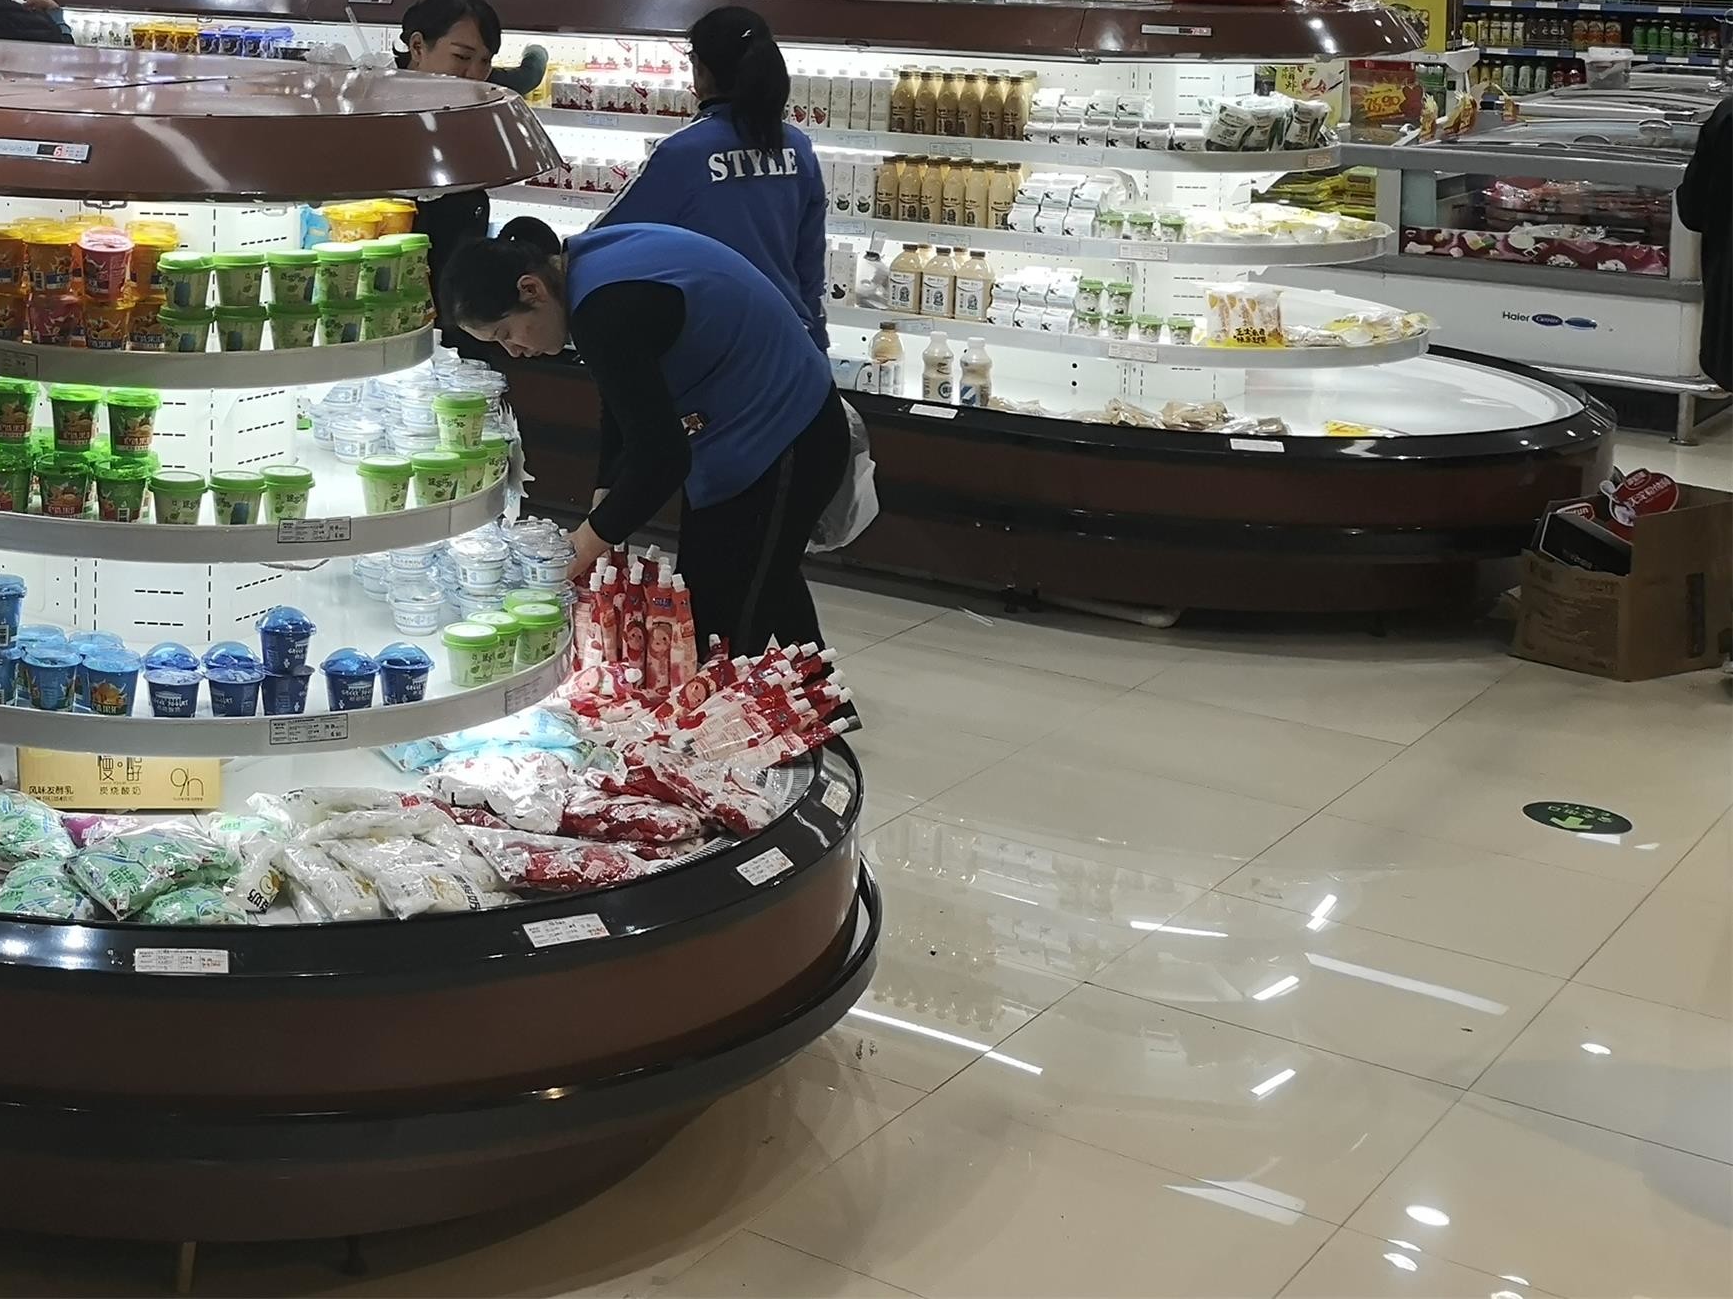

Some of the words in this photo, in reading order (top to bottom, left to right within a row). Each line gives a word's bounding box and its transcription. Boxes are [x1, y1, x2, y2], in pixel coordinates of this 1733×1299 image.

[708, 148, 799, 182] STYLE
[1502, 311, 1530, 322] Haier
[28, 784, 75, 796] 风味发酵乳
[99, 786, 142, 796] 炭烧酸奶
